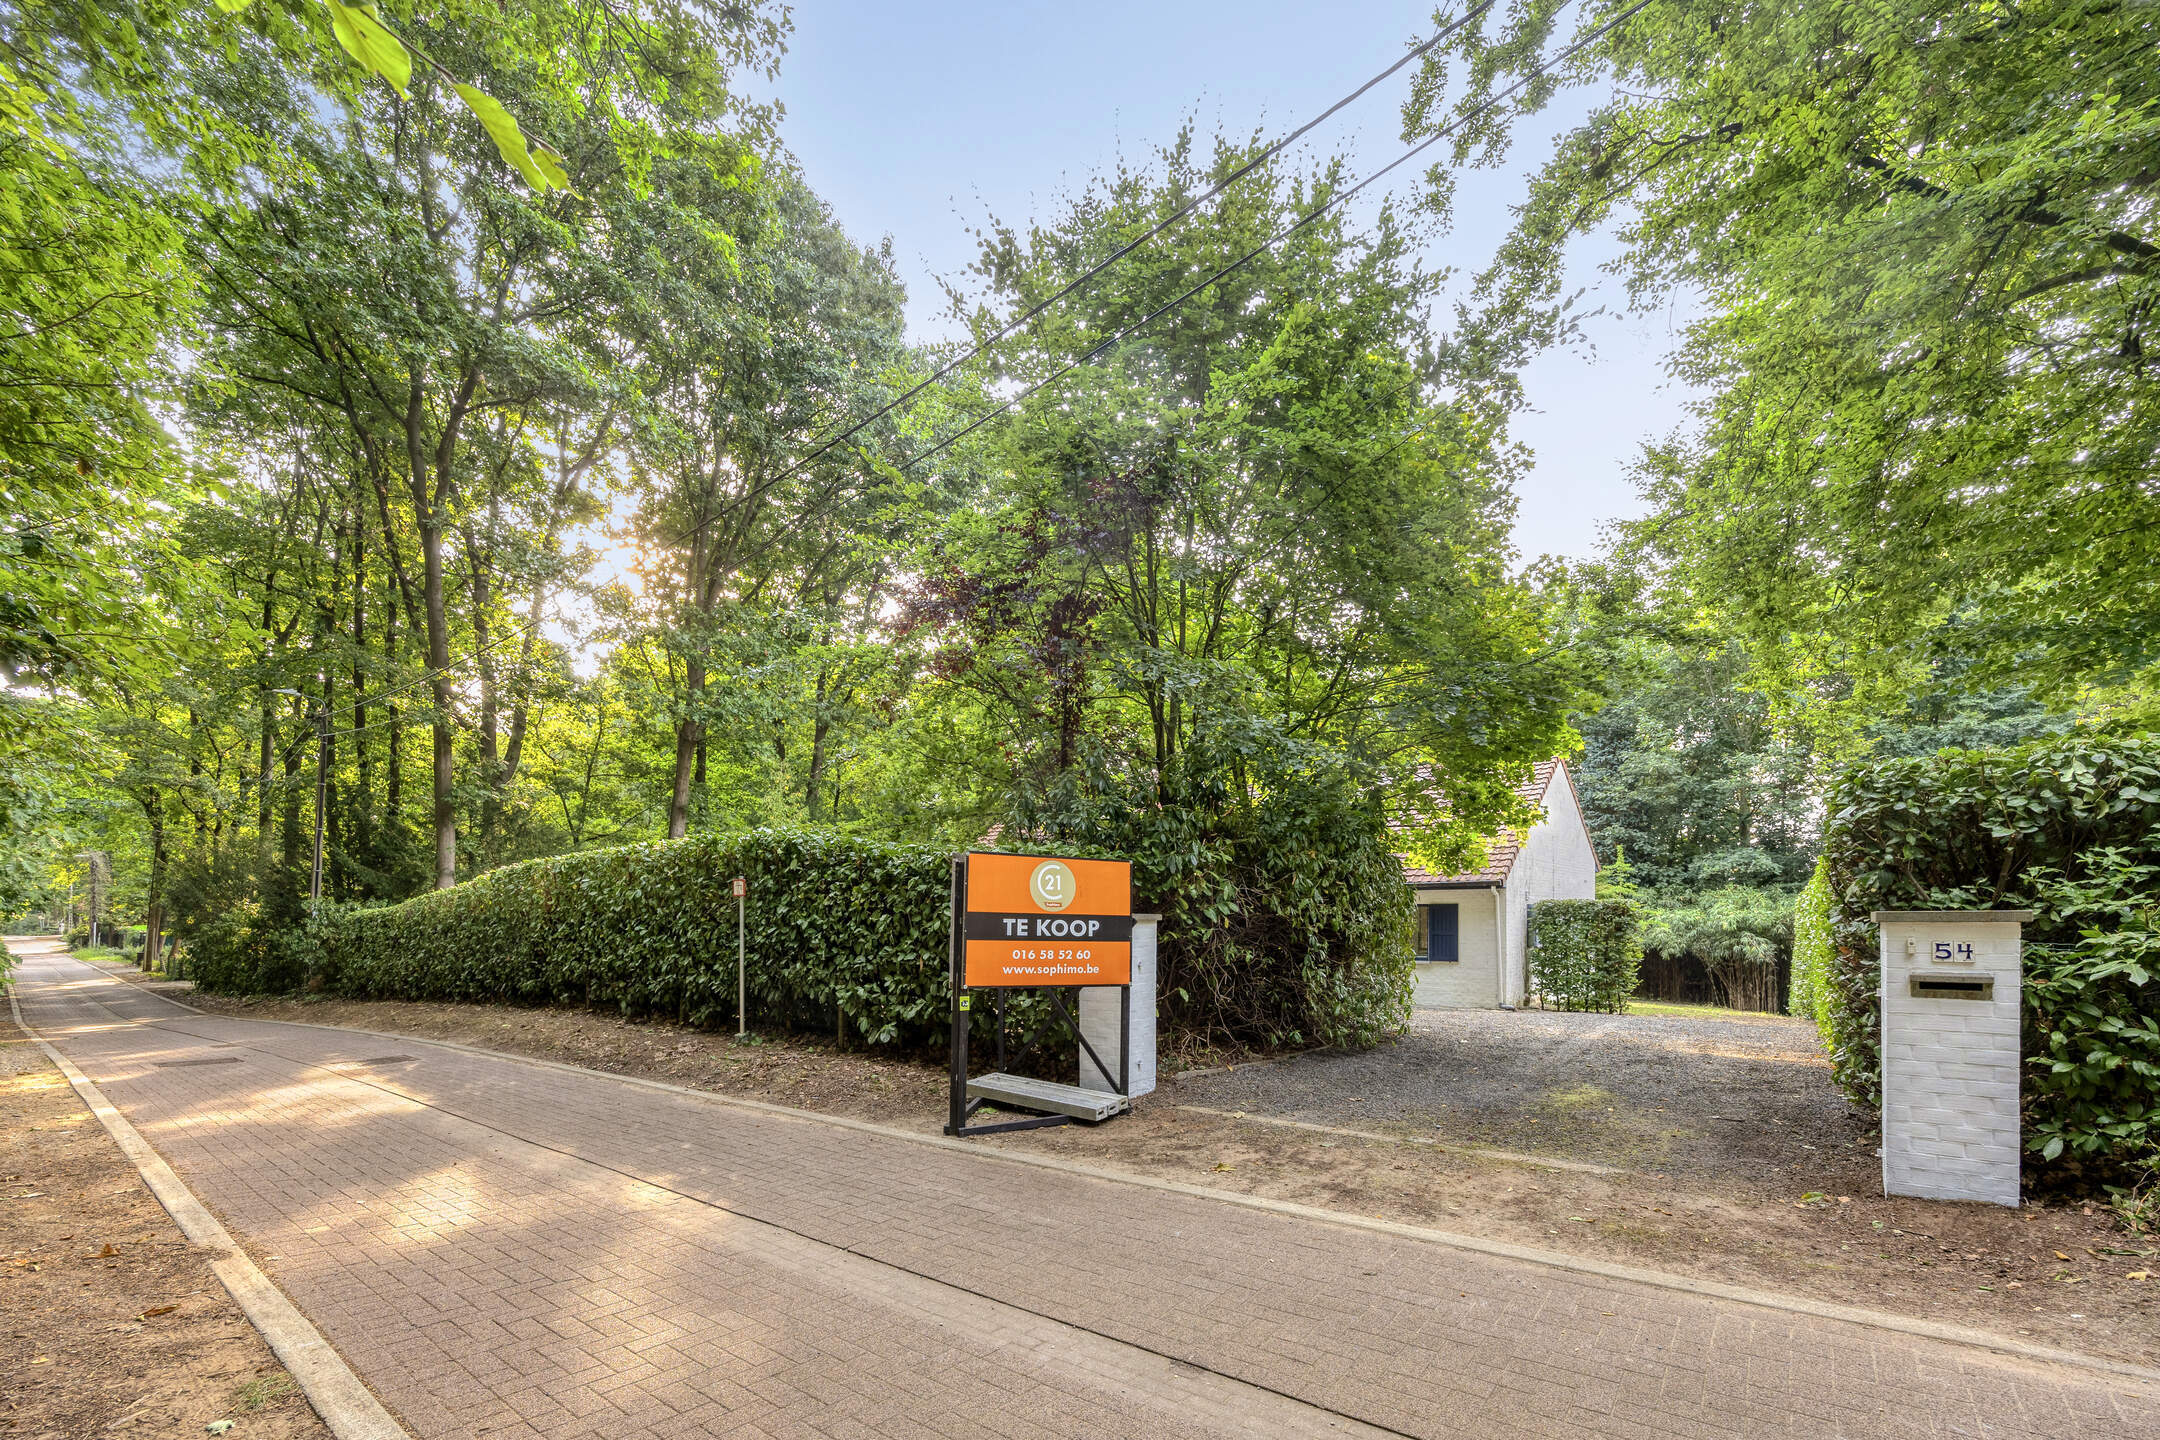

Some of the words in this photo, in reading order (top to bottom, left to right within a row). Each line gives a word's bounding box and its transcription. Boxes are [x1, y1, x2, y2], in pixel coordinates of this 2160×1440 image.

[1003, 918, 1028, 936] TE
[1036, 919, 1100, 937] KOOP
[1012, 950, 1036, 960] 016
[1039, 950, 1054, 960] 58
[1058, 950, 1072, 960] 52
[1076, 950, 1091, 960] 60
[1935, 942, 1974, 960] 54
[1002, 964, 1099, 976] www.sophimo.be
